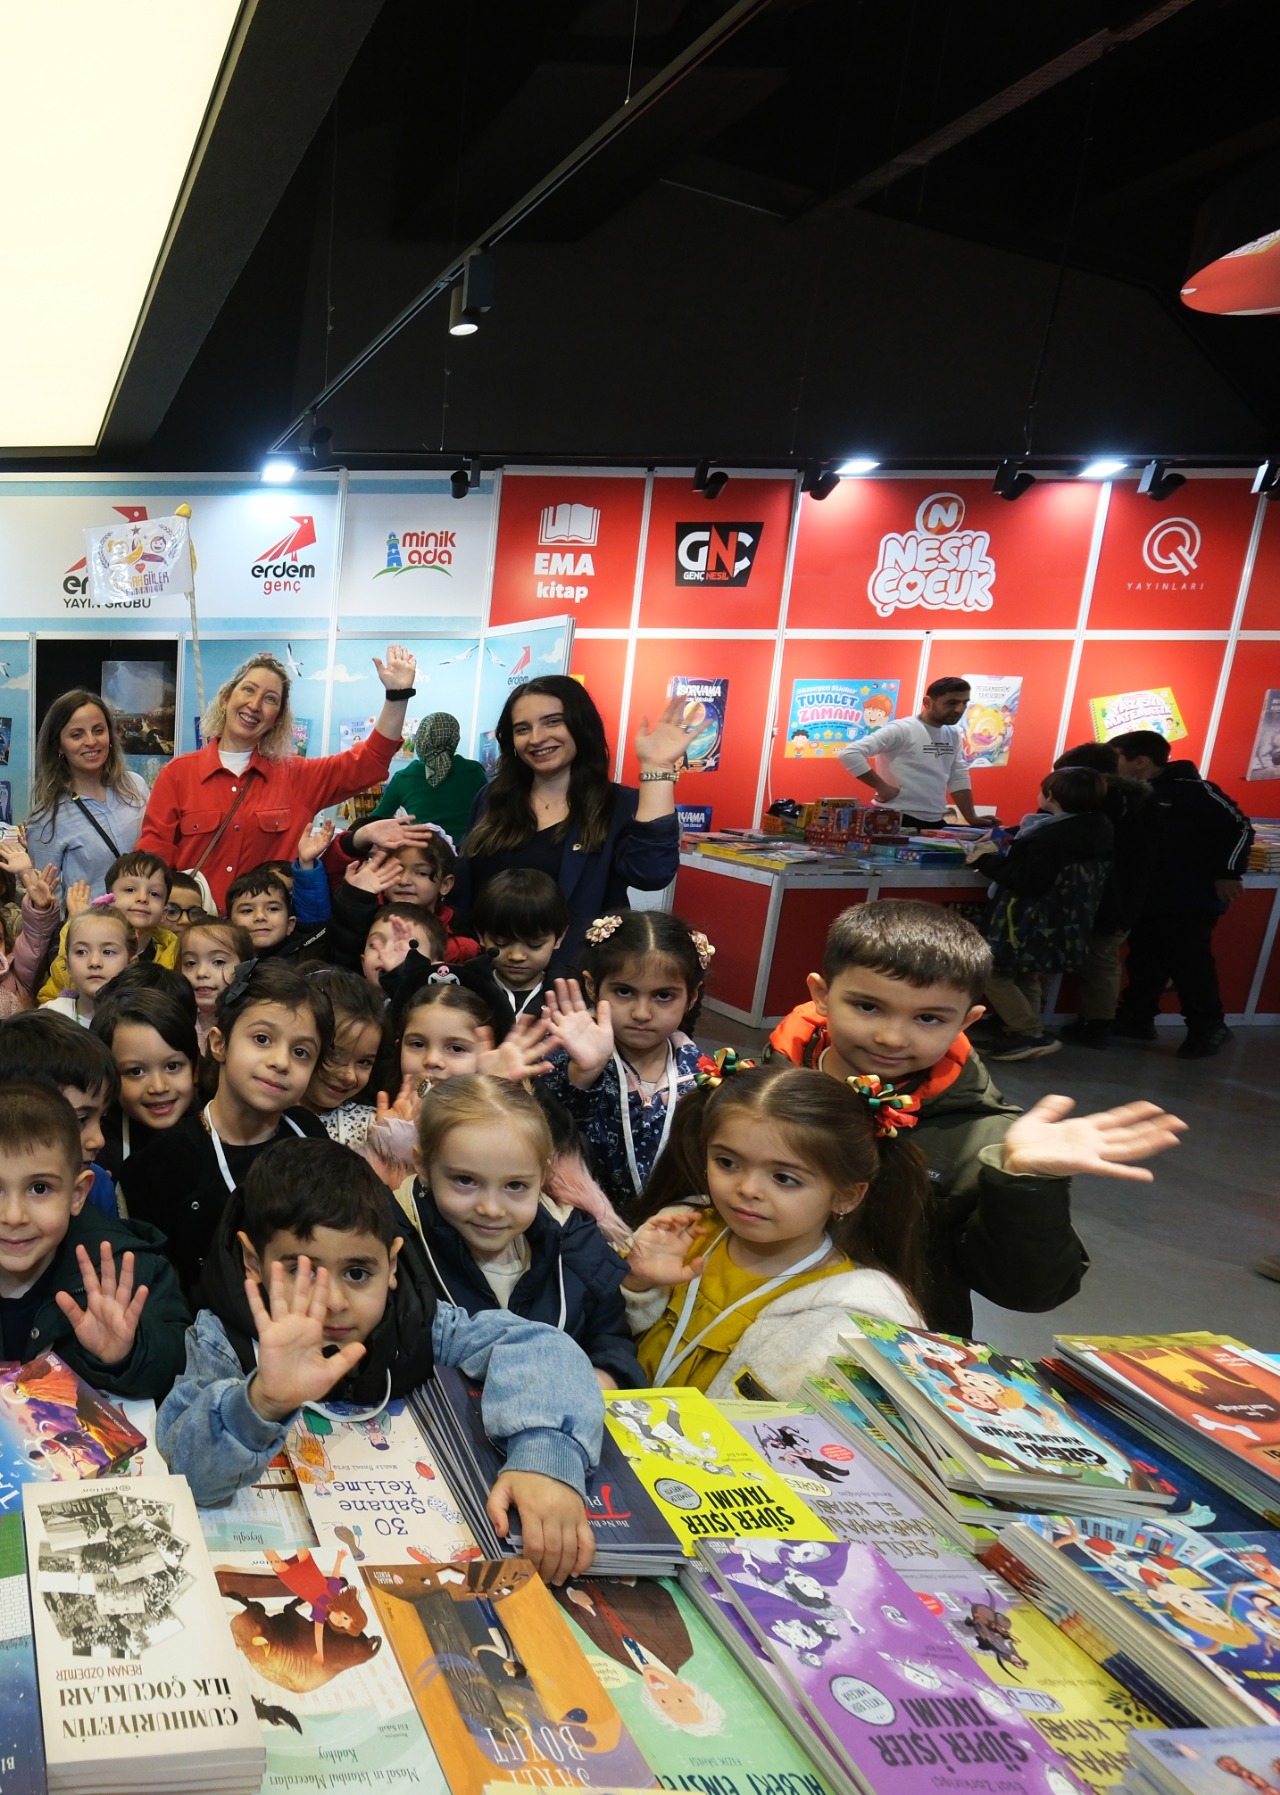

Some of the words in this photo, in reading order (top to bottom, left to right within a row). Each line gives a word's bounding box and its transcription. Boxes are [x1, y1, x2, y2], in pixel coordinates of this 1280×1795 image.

[401, 530, 457, 549] minik
[407, 546, 452, 565] ada
[677, 524, 754, 578] GNC
[882, 536, 991, 573] NESİL
[251, 561, 315, 578] erdem
[534, 552, 595, 576] EMA
[683, 571, 705, 582] GENÇ
[706, 571, 729, 580] NESİL
[263, 580, 301, 594] genç
[536, 581, 589, 603] kitap
[871, 567, 993, 616] ÇOCUK
[1127, 582, 1204, 591] YAYINLARI
[798, 693, 858, 707] TUVALET
[799, 708, 862, 723] ZAMANI
[332, 1480, 417, 1495] Kelime
[703, 1484, 776, 1510] TAKIMI
[338, 1497, 426, 1515] Şahane
[866, 1501, 904, 1518] EL
[374, 1517, 408, 1537] 30
[680, 1507, 741, 1538] İŞLER
[740, 1505, 796, 1537] SÜPER
[232, 1531, 265, 1545] Beyoğlu
[107, 1664, 143, 1677] RENAN
[58, 1675, 187, 1707] ÇOCUKLARI
[192, 1677, 232, 1701] İLK
[898, 1697, 998, 1729] TAKIMI
[61, 1706, 239, 1743] CUMHURİYETİN
[483, 1724, 585, 1764] BOYUT
[869, 1727, 954, 1774] İŞLER
[942, 1729, 1029, 1773] SÜPER
[317, 1746, 359, 1764] Kadıköy
[268, 1773, 327, 1790] Maceraları
[328, 1770, 372, 1788] İstanbul
